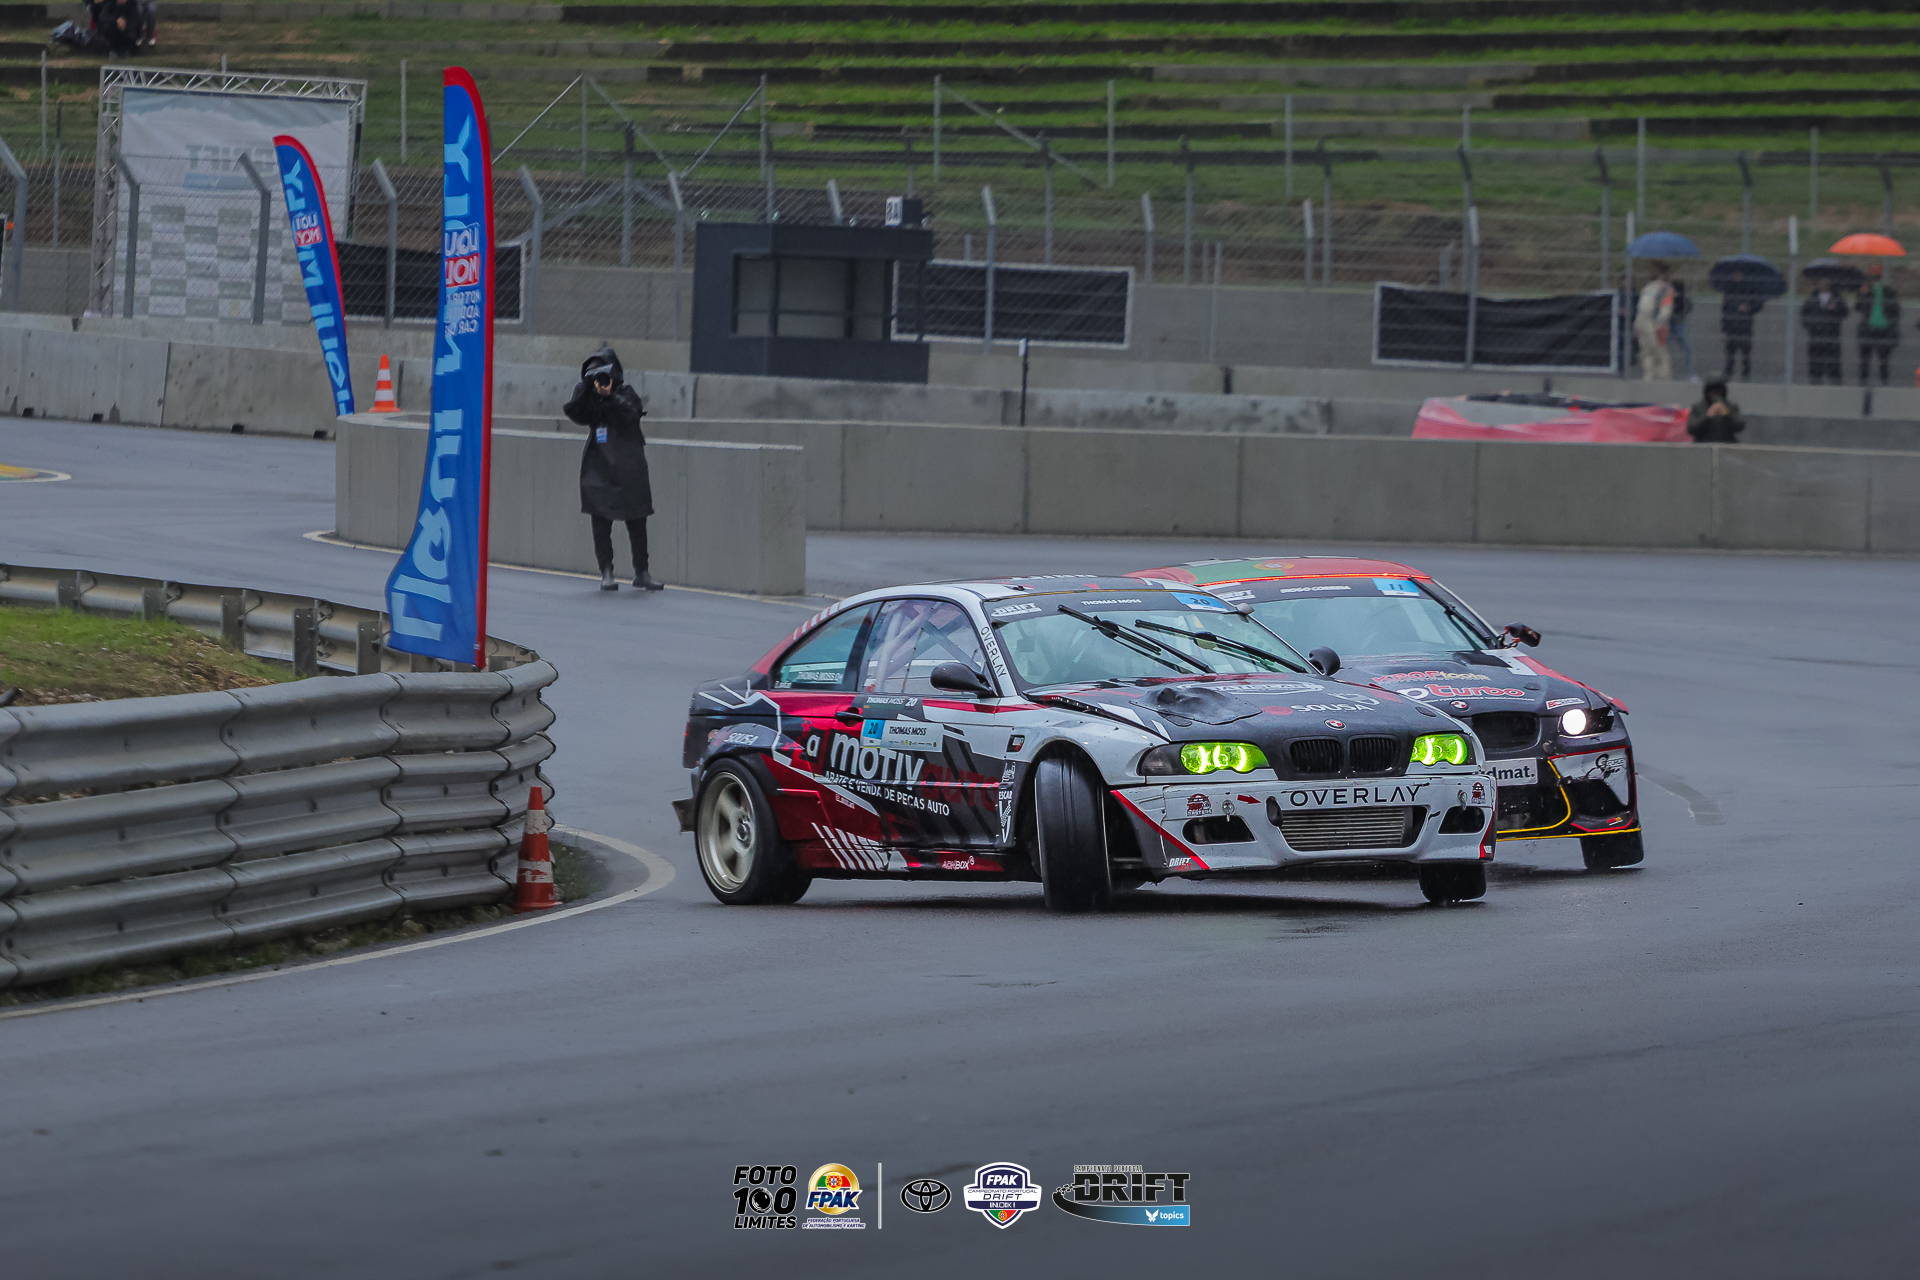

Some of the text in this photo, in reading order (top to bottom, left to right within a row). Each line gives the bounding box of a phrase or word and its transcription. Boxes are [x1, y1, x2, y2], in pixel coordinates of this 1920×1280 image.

[1189, 597, 1211, 606] 20
[980, 625, 1007, 678] OVERLAY
[905, 697, 919, 707] 20
[1290, 703, 1374, 712] SOUSA
[867, 722, 879, 735] 20
[889, 726, 928, 736] THOMAS MOSS
[723, 732, 759, 746] SOUSA
[806, 734, 821, 758] a
[855, 780, 882, 798] VENDA
[884, 788, 895, 802] DE
[927, 799, 950, 816] AUTO
[1289, 784, 1421, 807] OVERLAY
[1169, 857, 1192, 867] DRIFT
